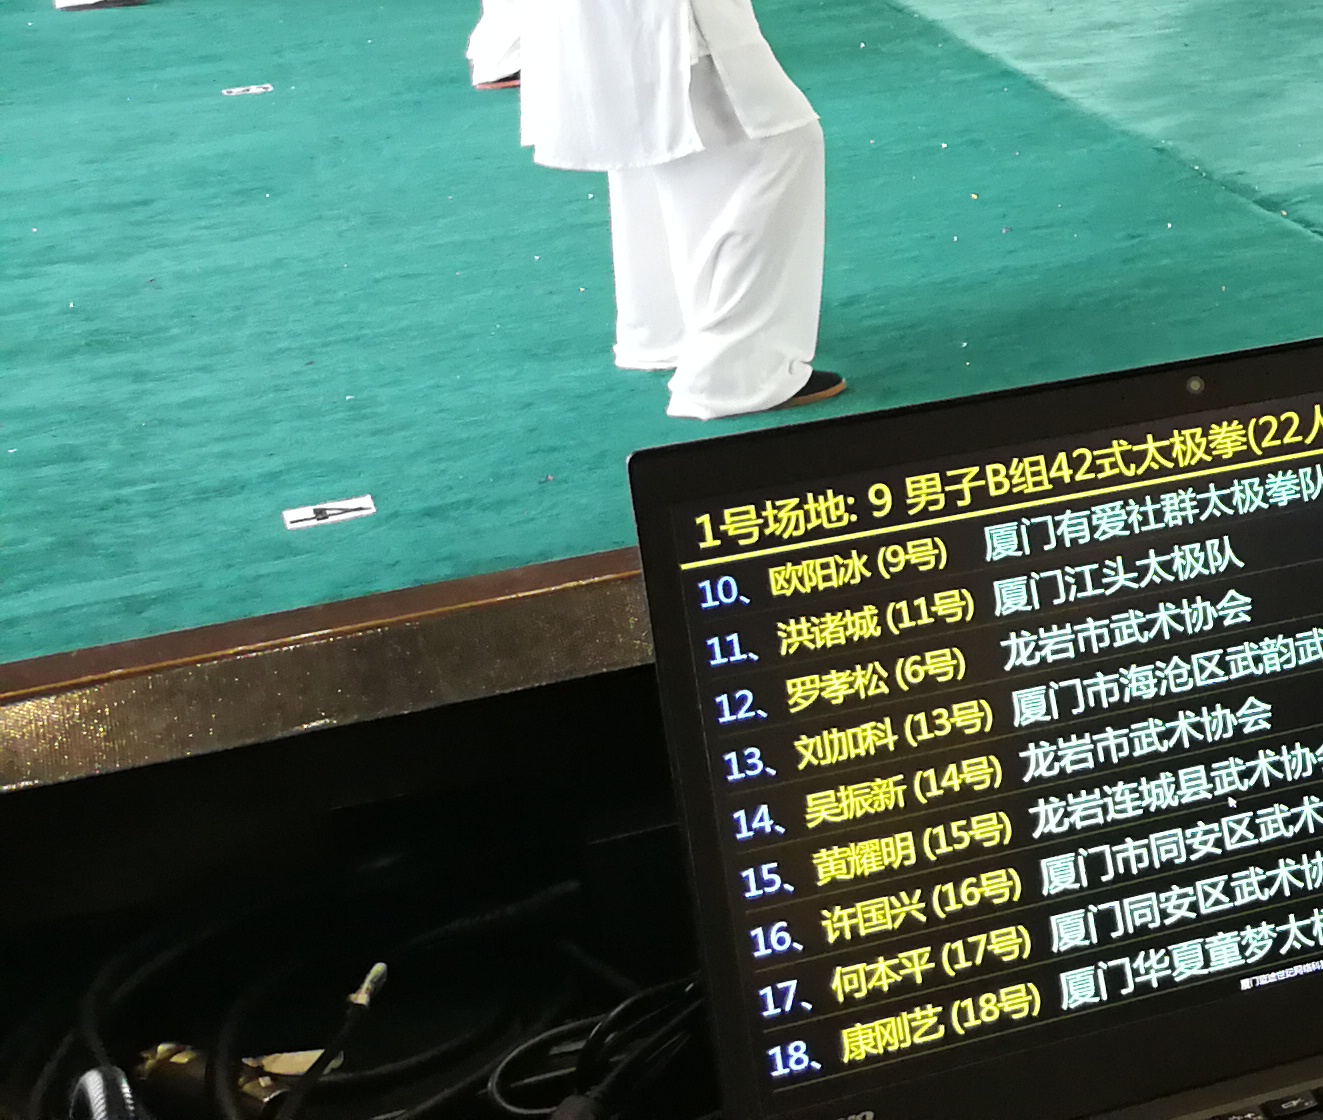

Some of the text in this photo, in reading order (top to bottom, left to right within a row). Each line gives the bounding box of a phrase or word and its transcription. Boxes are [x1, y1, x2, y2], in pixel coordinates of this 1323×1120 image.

[695, 489, 860, 549] 1号场地:
[867, 482, 893, 518] 9
[698, 575, 751, 610] 10、
[768, 549, 872, 598] 欧阳冰
[877, 537, 948, 580] (9号)
[706, 632, 760, 667] 11、
[777, 604, 881, 657] 洪诸城
[886, 588, 975, 636] (11号)
[993, 535, 1245, 618] 厦门江头太极队
[715, 689, 768, 724] 12、
[786, 662, 890, 714] 罗孝松
[896, 647, 966, 692] (6号)
[1000, 588, 1253, 672] 龙岩市武术协会
[723, 746, 777, 782] 13、
[794, 717, 898, 770] 刘加科
[904, 699, 994, 748] (13号)
[732, 804, 786, 840] 14、
[805, 773, 907, 829] 吴振新
[913, 754, 1003, 805] (14号)
[1018, 696, 1273, 783] 龙岩市武术协会
[741, 862, 795, 899] 15、
[812, 831, 917, 887] 黄耀明
[923, 811, 1013, 861] (15号)
[750, 920, 804, 958] 16、
[820, 888, 927, 944] 许国兴
[932, 867, 1022, 918] (16号)
[759, 979, 813, 1017] 17、
[831, 946, 935, 1003] 何本平
[942, 925, 1032, 977] (17号)
[768, 1040, 822, 1077] 18、
[841, 1003, 945, 1064] 康刚艺
[951, 982, 1042, 1035] (18号)
